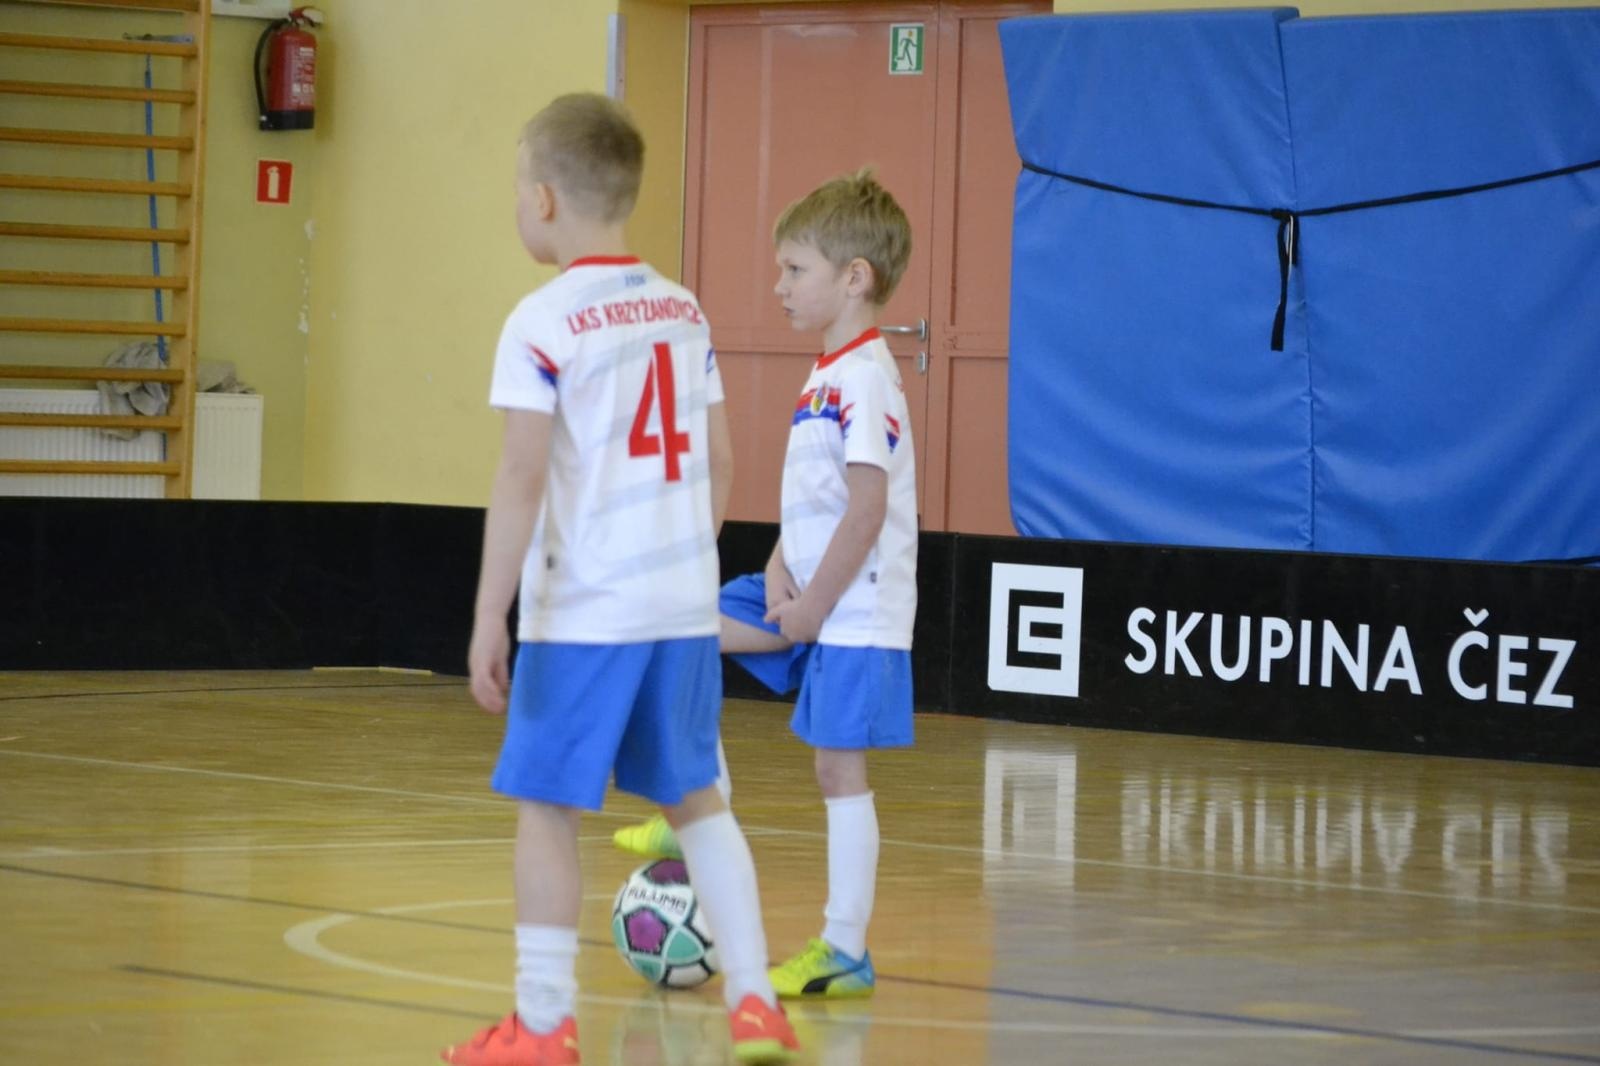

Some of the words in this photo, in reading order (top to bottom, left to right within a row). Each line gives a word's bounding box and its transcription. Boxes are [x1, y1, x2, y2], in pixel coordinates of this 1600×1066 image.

[567, 306, 602, 336] LKS
[628, 341, 691, 483] 4
[1124, 607, 1423, 695] SKUPINA
[1447, 607, 1576, 708] ČEZ
